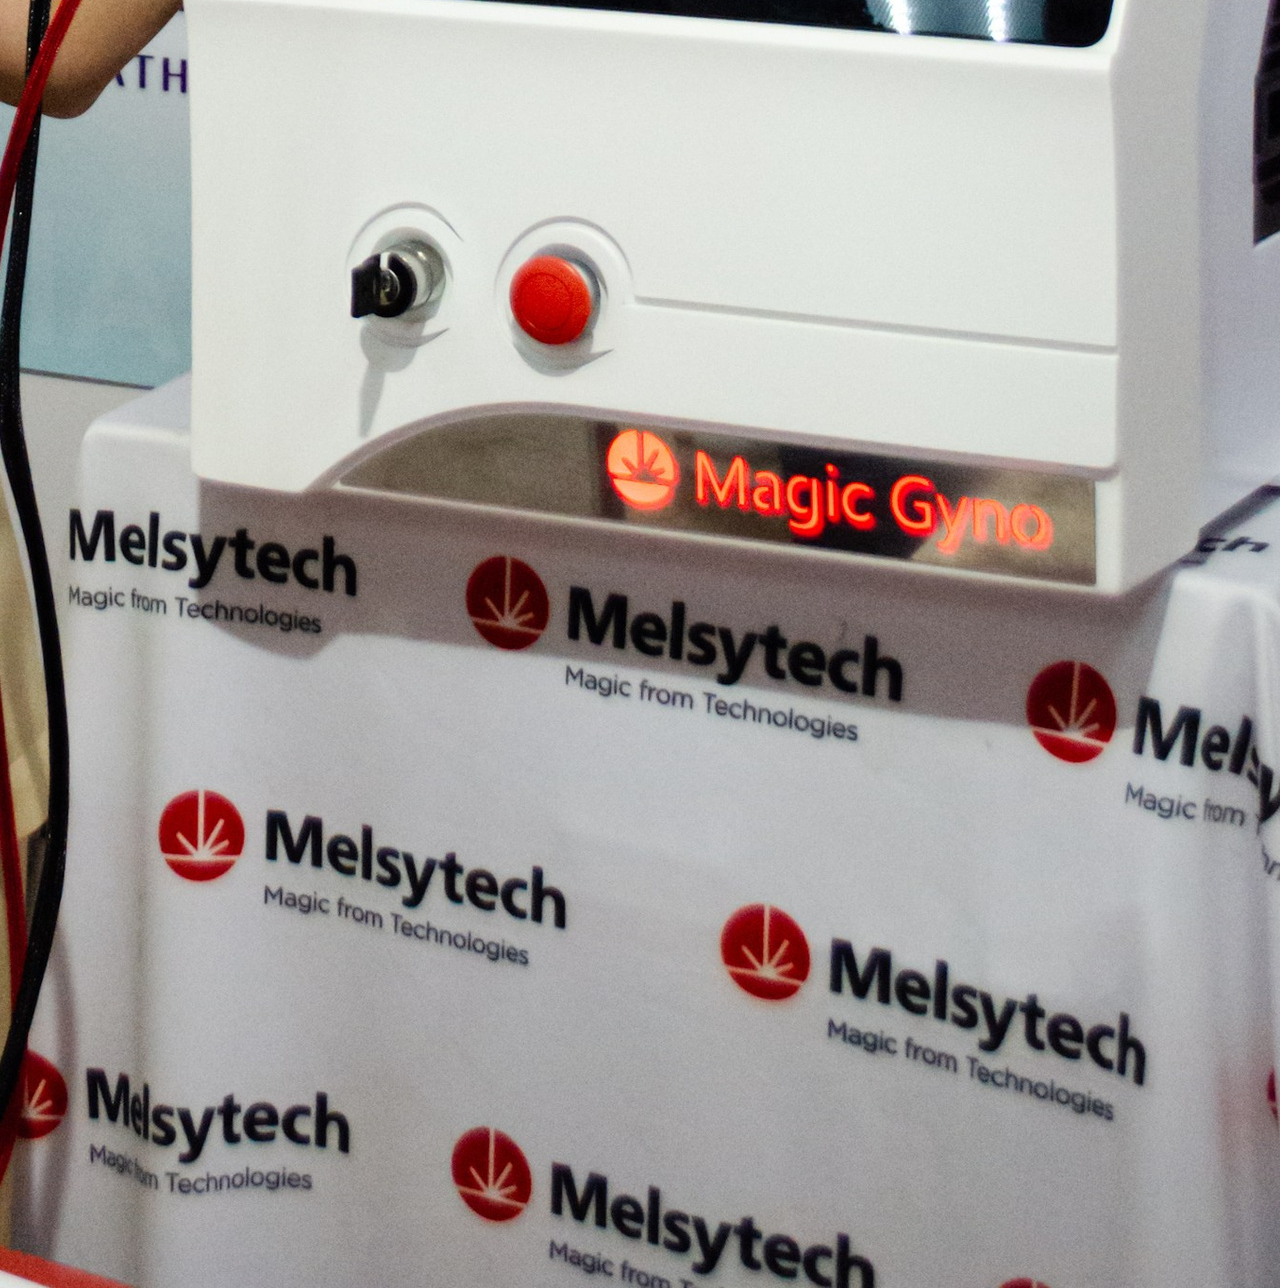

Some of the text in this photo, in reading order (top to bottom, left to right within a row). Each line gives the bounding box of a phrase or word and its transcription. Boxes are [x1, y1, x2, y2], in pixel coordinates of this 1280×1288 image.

[694, 453, 1054, 556] Magic Gyno
[69, 508, 358, 597] Melsytech
[69, 584, 322, 634] Magic from Technologies
[567, 585, 904, 702] Melsytech
[564, 665, 859, 741] Magic from Technologies
[1125, 781, 1246, 827] Magic from
[264, 808, 568, 929] Melsytech
[263, 885, 530, 966] Magic from Technologies
[829, 936, 1148, 1086] Melsytech
[86, 1066, 351, 1163] Melsytech
[827, 1018, 1115, 1121] Magic from Technologies
[166, 1166, 313, 1195] Technologies
[550, 1161, 876, 1288] Melsytech
[549, 1239, 614, 1278] Magic
